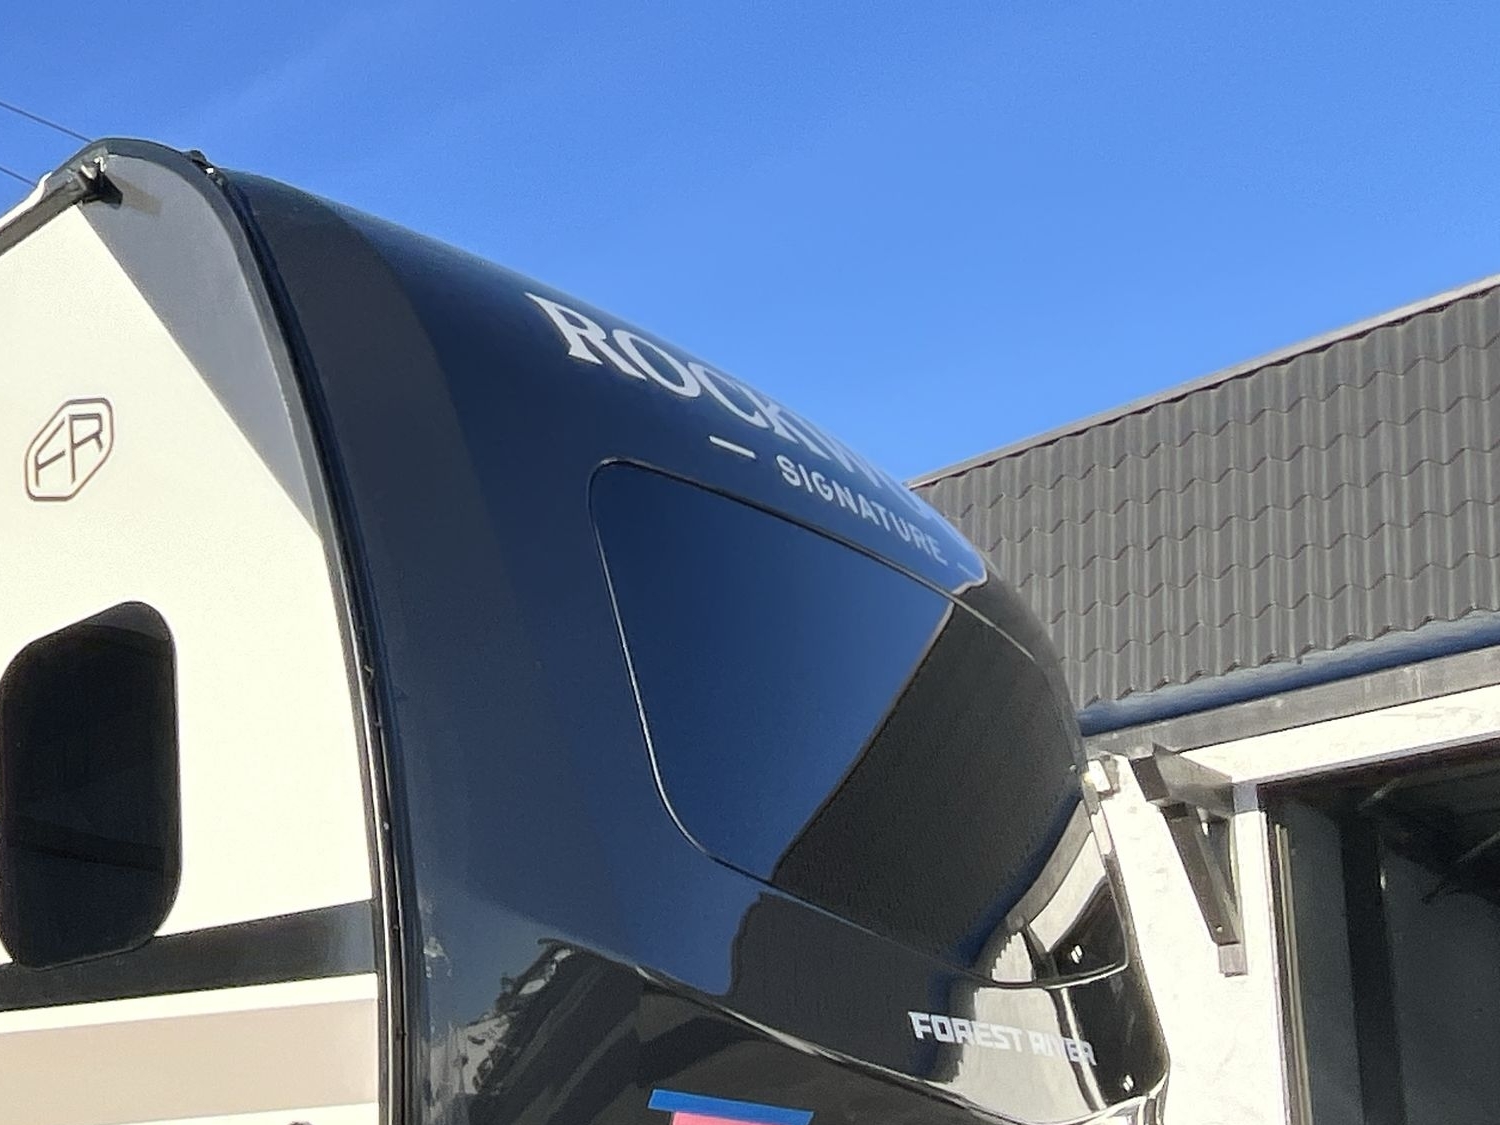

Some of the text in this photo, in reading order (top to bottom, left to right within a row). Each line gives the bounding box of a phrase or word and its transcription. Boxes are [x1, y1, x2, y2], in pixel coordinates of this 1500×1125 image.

[775, 454, 948, 565] SIGNATURE
[908, 1011, 1098, 1066] FOREST RIVER
